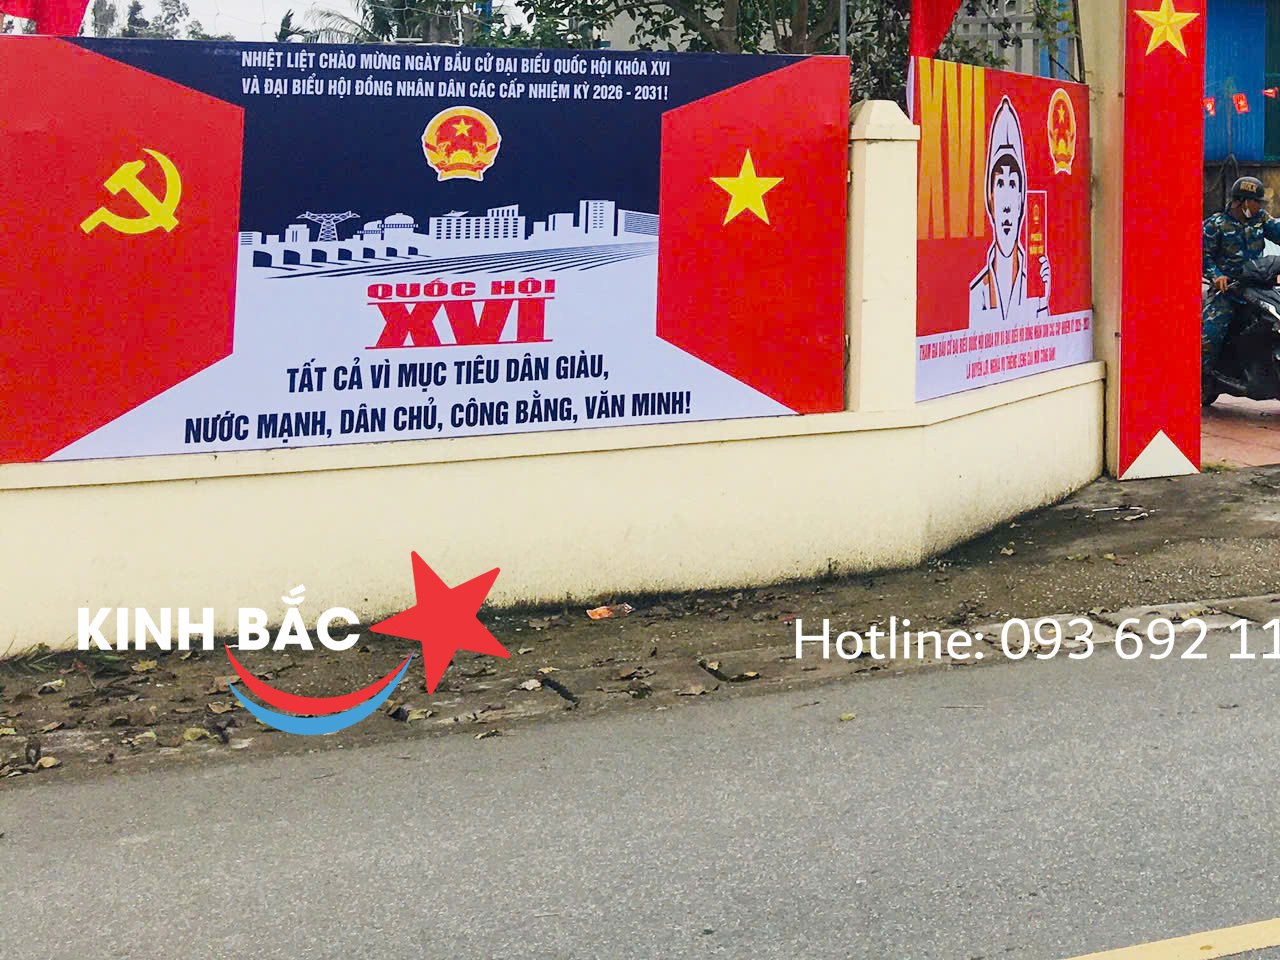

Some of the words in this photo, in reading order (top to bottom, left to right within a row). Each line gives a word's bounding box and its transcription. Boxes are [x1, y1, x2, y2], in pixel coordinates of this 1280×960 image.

[241, 48, 283, 70] NHIỆT
[287, 49, 315, 71] LIỆT
[319, 52, 356, 69] CHÀO
[360, 51, 400, 70] MỪNG
[405, 52, 441, 71] NGÀY
[445, 51, 470, 73] BẦU
[475, 51, 494, 73] CỬ
[496, 58, 517, 76] ĐẠI
[521, 53, 550, 73] BIỂU
[554, 54, 587, 75] QUỐC
[591, 57, 611, 78] HỘI
[615, 57, 647, 75] KHÓA
[650, 61, 670, 76] XVI
[242, 75, 260, 94] VÀ
[264, 78, 287, 98] ĐẠI
[292, 73, 324, 95] BIỂU
[328, 77, 350, 99] HỘI
[355, 75, 392, 96] ĐỒNG
[397, 78, 434, 97] NHÂN
[438, 79, 465, 98] DÂN
[470, 79, 495, 98] CÁC
[500, 78, 524, 99] CẤP
[529, 81, 569, 102] NHIỆM
[574, 81, 589, 99] KỲ
[593, 85, 622, 100] 2026
[635, 86, 668, 100] 2031!
[917, 56, 985, 239] XVI
[367, 278, 476, 300] QUỐC
[491, 278, 555, 296] HỘI
[365, 297, 555, 349] XVI
[287, 358, 326, 393] TẤT
[334, 357, 363, 391] CẢ
[371, 359, 390, 389] VÌ
[399, 361, 446, 392] MỤC
[454, 355, 499, 385] TIÊU
[506, 353, 548, 383] DÂN
[556, 350, 609, 380] GIÀU,
[184, 411, 249, 443] NƯỚC
[257, 411, 332, 443] MẠNH,
[340, 403, 386, 434] DÂN
[393, 397, 443, 432] CHỦ,
[450, 398, 508, 428] CÔNG
[516, 390, 577, 424] BẰNG,
[585, 391, 625, 420] VĂN
[632, 391, 691, 416] MINH!
